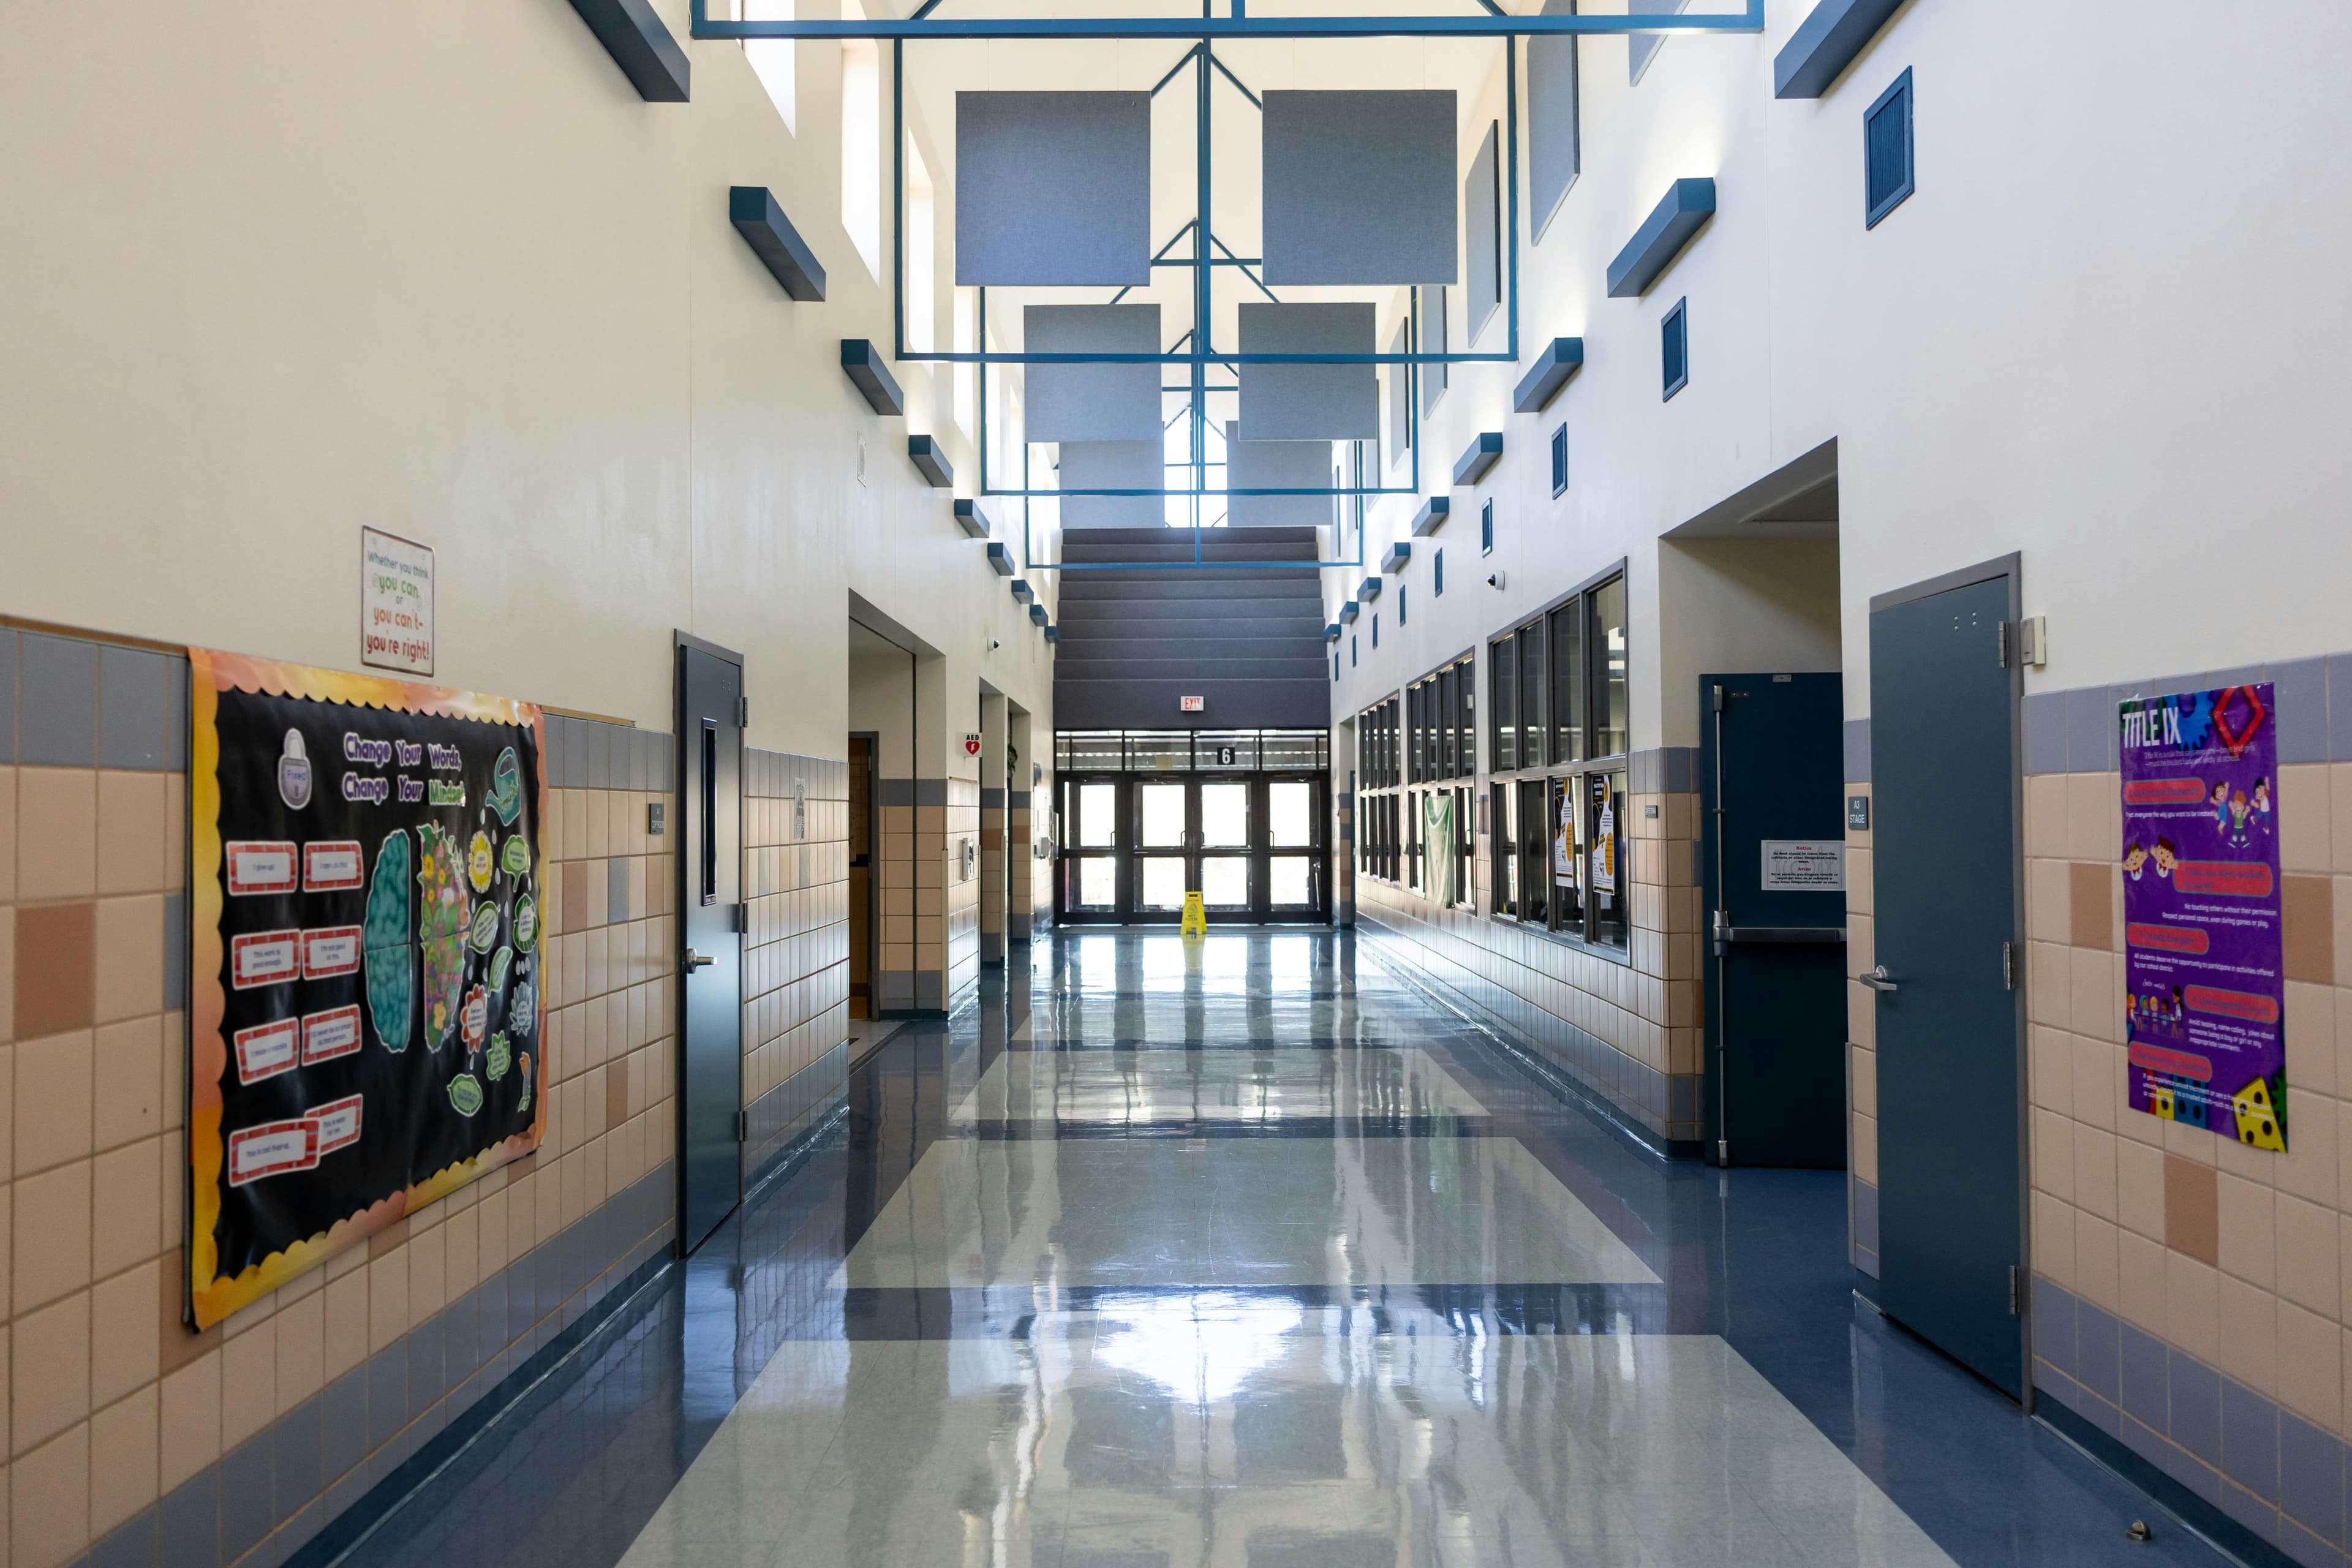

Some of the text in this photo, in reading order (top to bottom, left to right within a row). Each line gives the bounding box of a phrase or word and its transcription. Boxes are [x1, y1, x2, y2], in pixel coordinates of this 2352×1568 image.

[399, 563, 412, 575] you
[413, 565, 429, 579] think
[379, 575, 419, 600] you can
[396, 595, 404, 605] or
[374, 608, 392, 626] you
[367, 630, 429, 663] you're right!
[1185, 697, 1200, 710] EXIT
[2122, 706, 2182, 748] TITLE IX
[343, 731, 462, 772] Change Your Words,
[1222, 748, 1231, 764] 6
[286, 769, 306, 781] Fixed
[342, 771, 389, 805] Change
[397, 775, 423, 803] Your
[1853, 800, 1860, 809] A3
[1849, 814, 1865, 824] STAGE
[2162, 912, 2177, 921] Respect
[2221, 917, 2234, 925] during
[2236, 918, 2250, 927] games
[2178, 959, 2201, 968] opportunity
[2207, 962, 2231, 971] participate
[2236, 965, 2255, 974] activities
[2189, 1028, 2207, 1036] someone
[2208, 1031, 2219, 1040] being
[2253, 1039, 2261, 1048] any
[2248, 1030, 2260, 1038] jokes
[2155, 1076, 2174, 1087] experience
[2189, 1085, 2209, 1095] treatment
